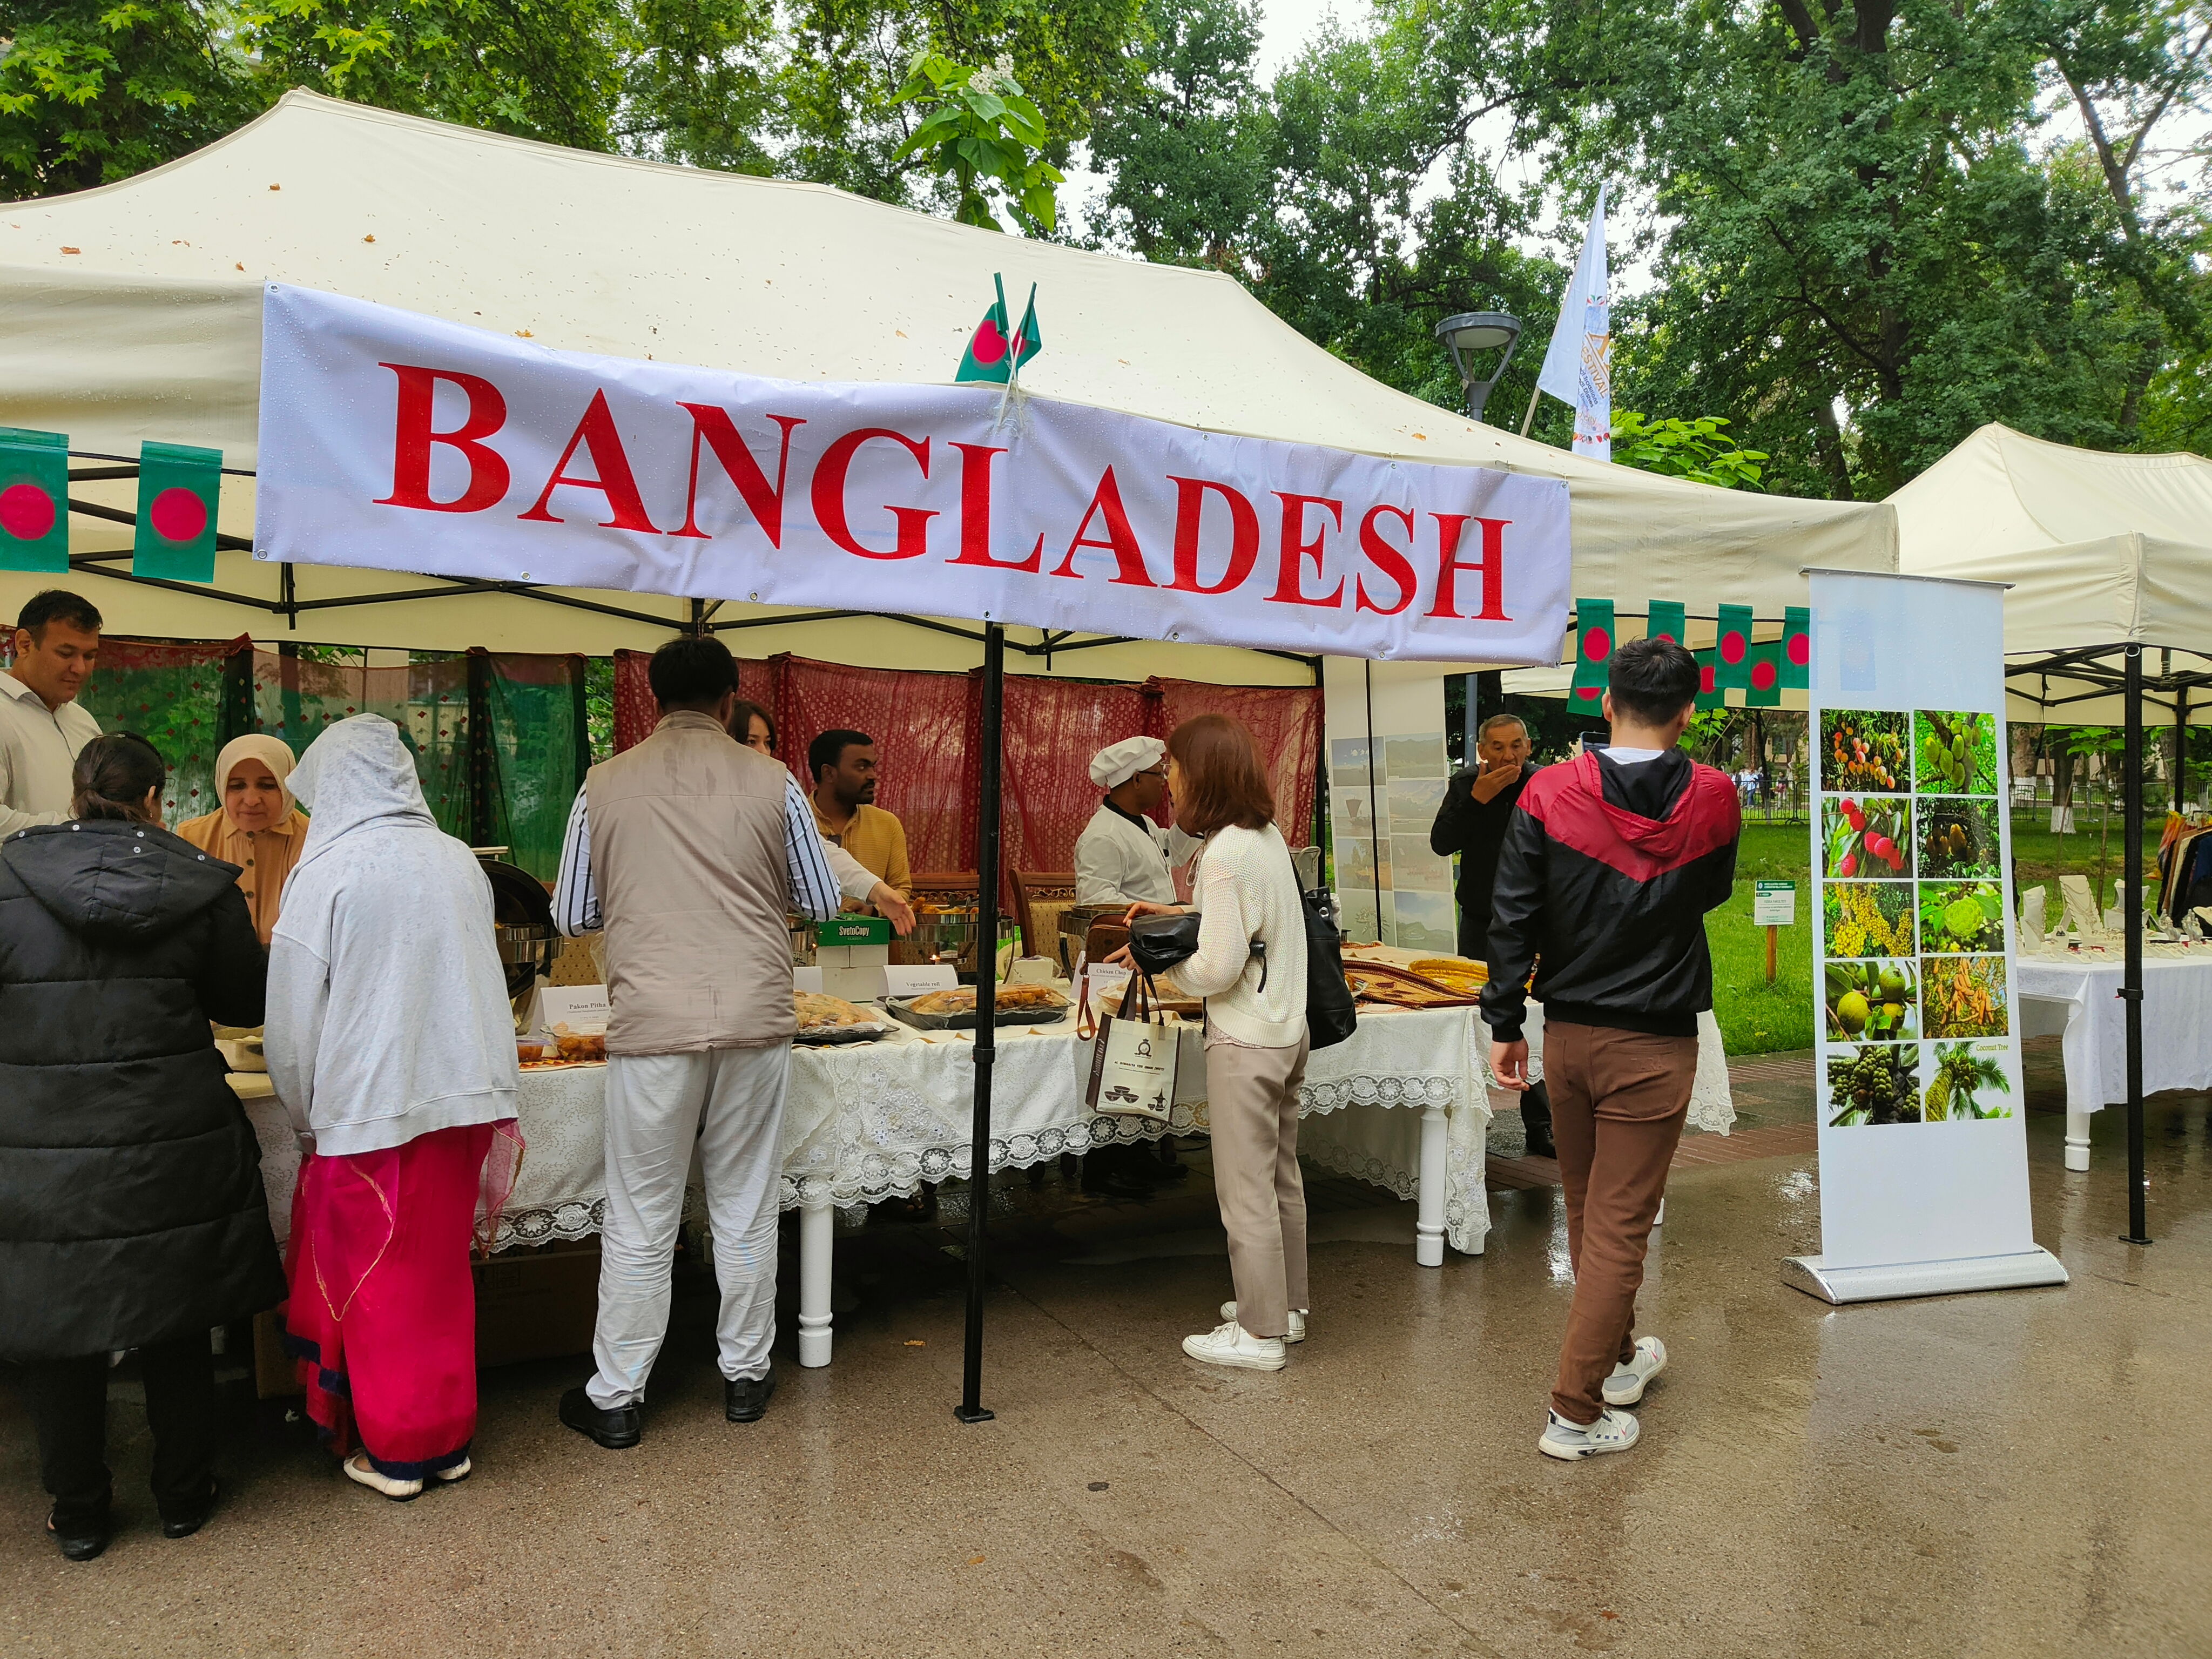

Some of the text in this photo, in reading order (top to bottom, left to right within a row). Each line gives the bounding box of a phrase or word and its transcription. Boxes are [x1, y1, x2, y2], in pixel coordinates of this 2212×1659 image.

[1581, 342, 1609, 399] ESTIVAL
[1583, 388, 1594, 408] Dishes
[1584, 374, 1599, 405] Traditions
[373, 362, 1513, 622] BANGLADESH
[839, 926, 869, 936] SvetoCopy
